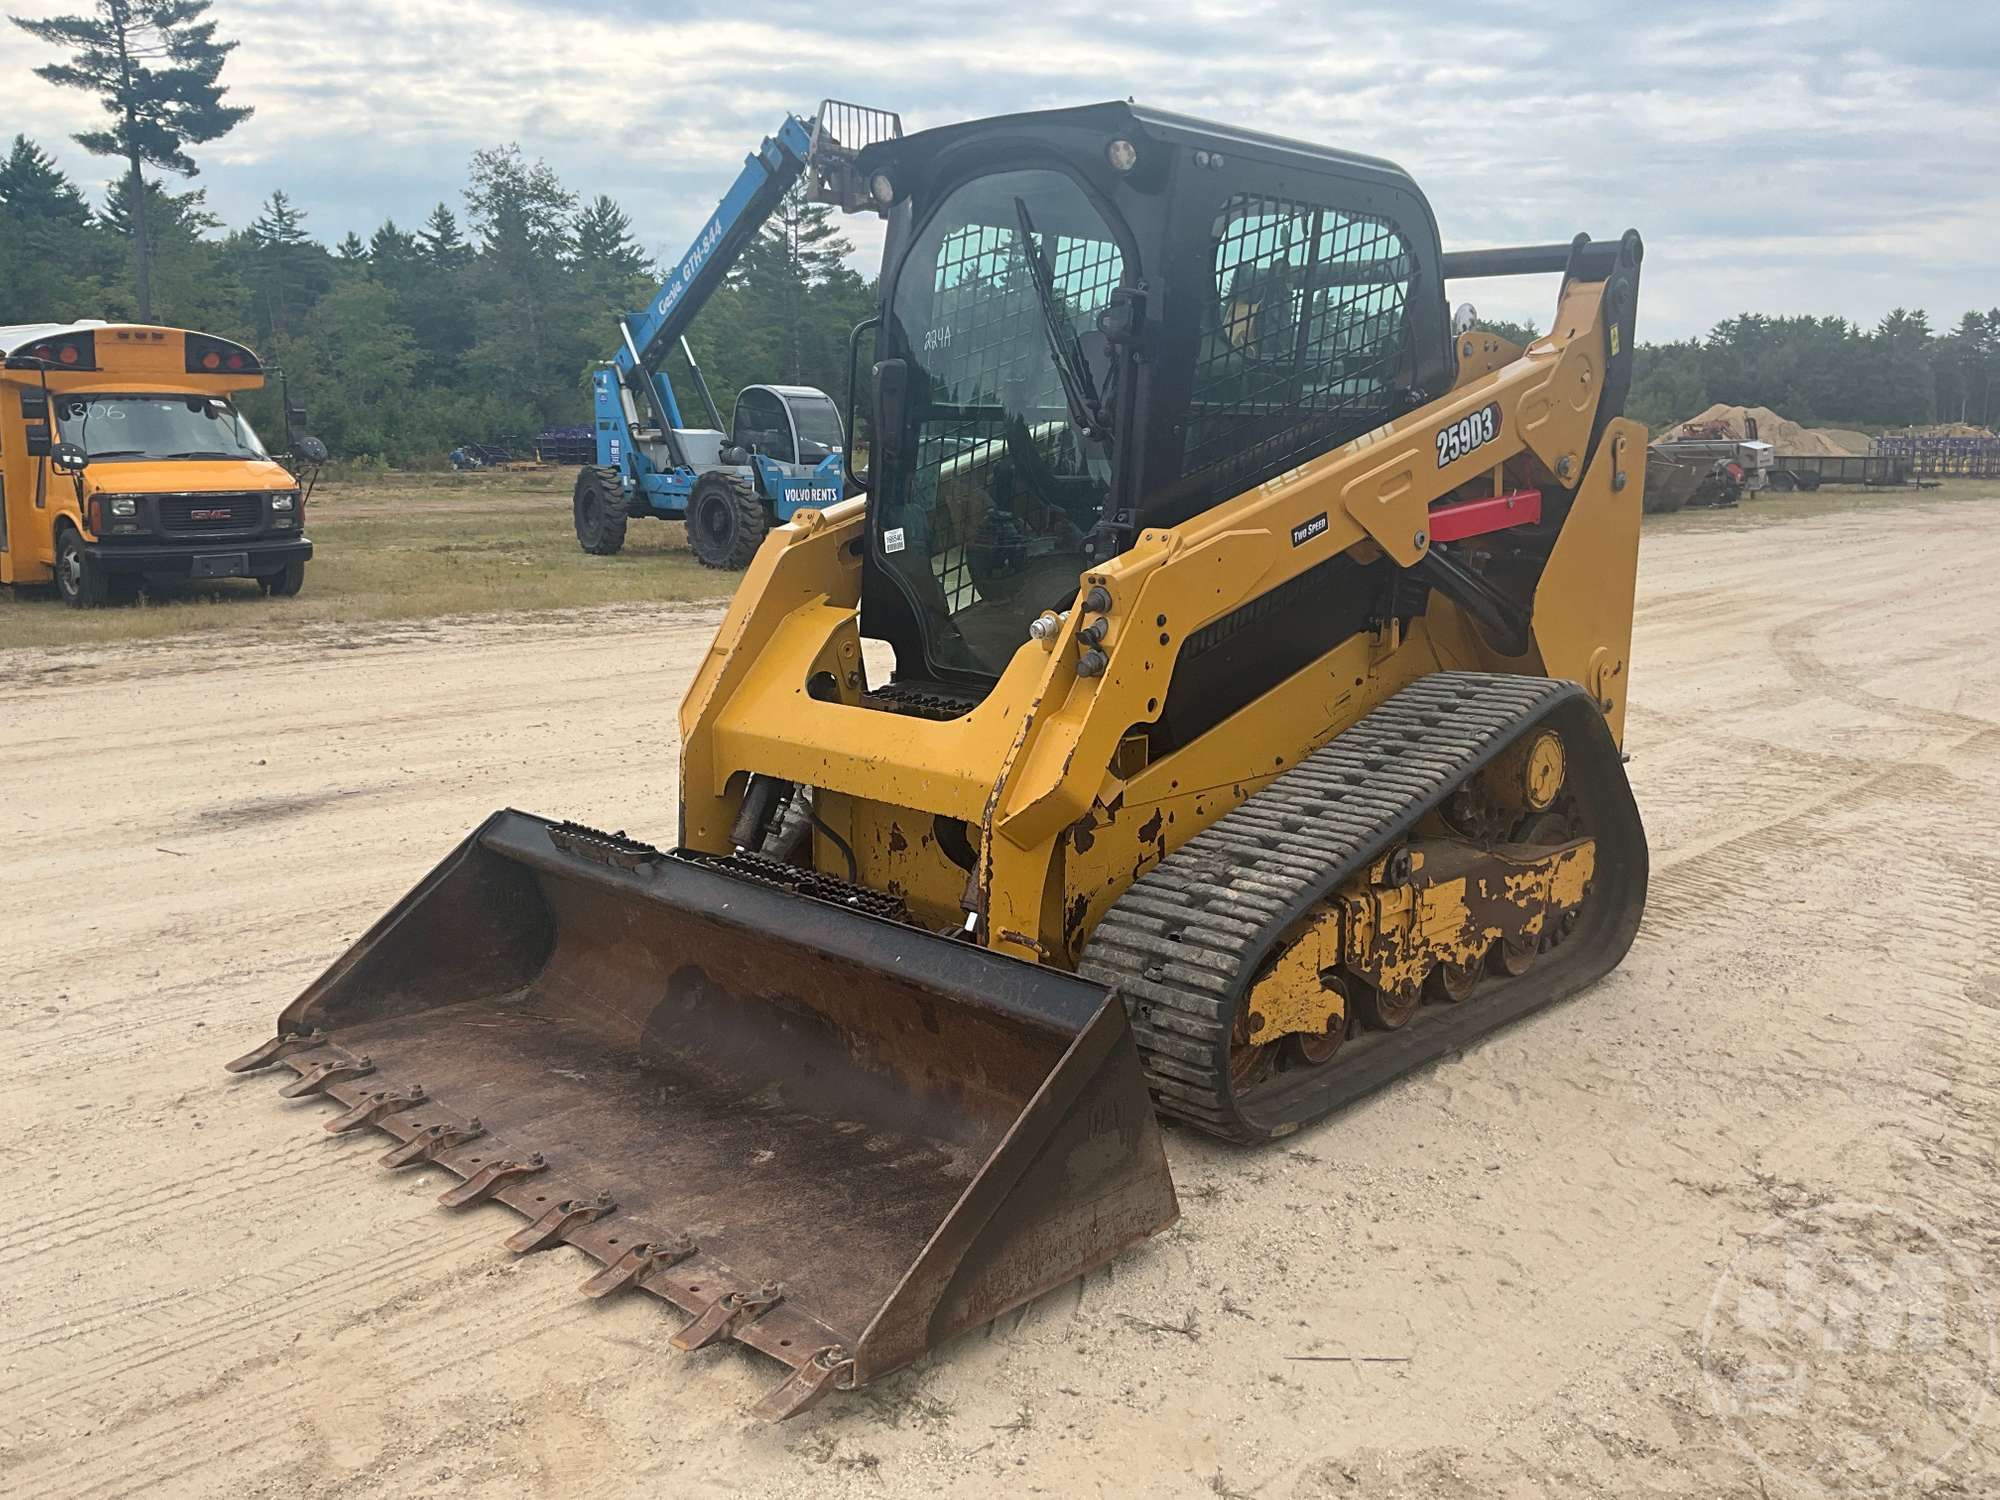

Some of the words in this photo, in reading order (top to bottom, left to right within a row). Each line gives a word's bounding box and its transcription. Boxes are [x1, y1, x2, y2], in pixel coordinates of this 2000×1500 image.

[659, 281, 682, 315] Genie
[683, 218, 722, 282] GTH-844
[69, 402, 127, 421] 306
[1436, 406, 1494, 468] 259D3
[784, 488, 810, 502] VOLVO
[811, 487, 838, 502] RENTS
[191, 509, 232, 520] GMC
